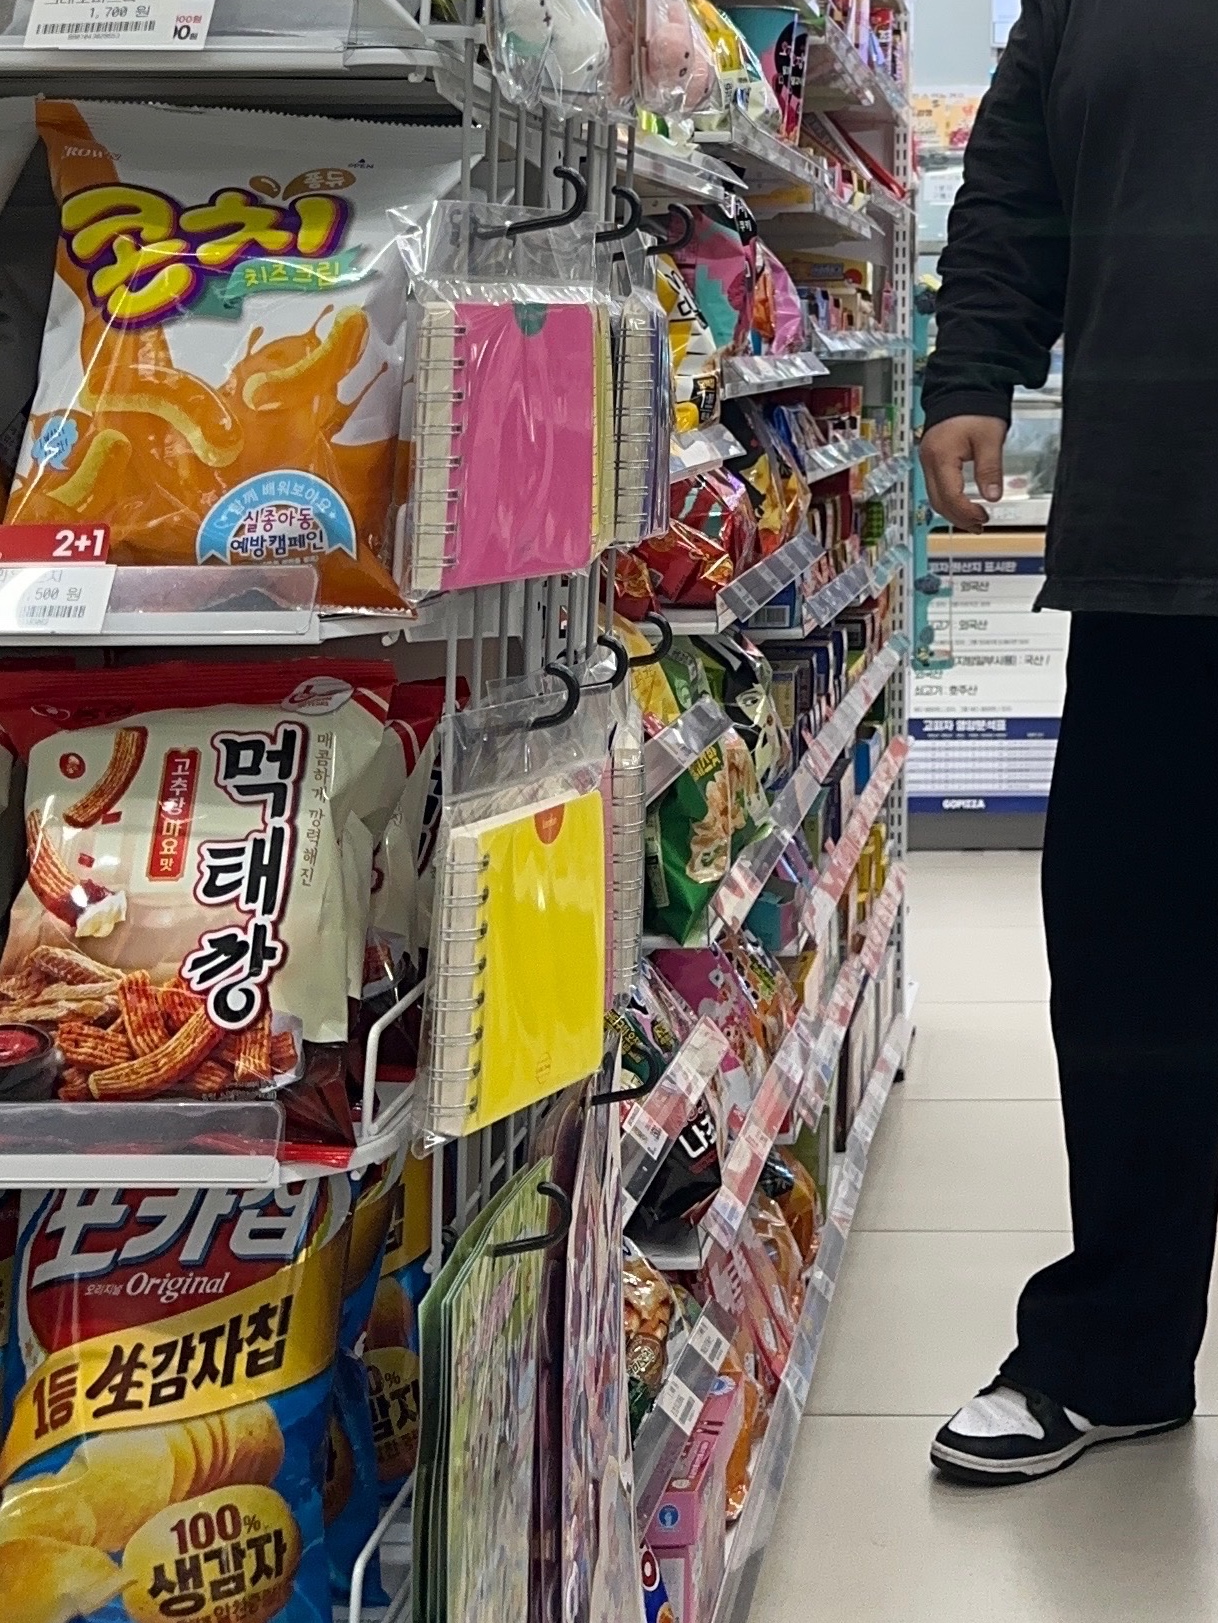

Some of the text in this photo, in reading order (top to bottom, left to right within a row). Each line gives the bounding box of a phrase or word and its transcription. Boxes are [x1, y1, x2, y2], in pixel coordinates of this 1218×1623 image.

[90, 7, 128, 19] 1,700
[245, 261, 340, 288] 치즈크림
[229, 480, 332, 515] 함께 배워보아요
[244, 507, 314, 533] 실종아동
[52, 529, 105, 557] 2+1
[230, 530, 324, 558] 예방캠페인
[311, 730, 333, 804] 매콤하게
[188, 729, 302, 1023] 먹태깡
[126, 1272, 229, 1303] Original
[33, 1364, 79, 1439] 1등
[170, 1504, 263, 1556] 100%
[149, 1529, 288, 1618] 생감자
